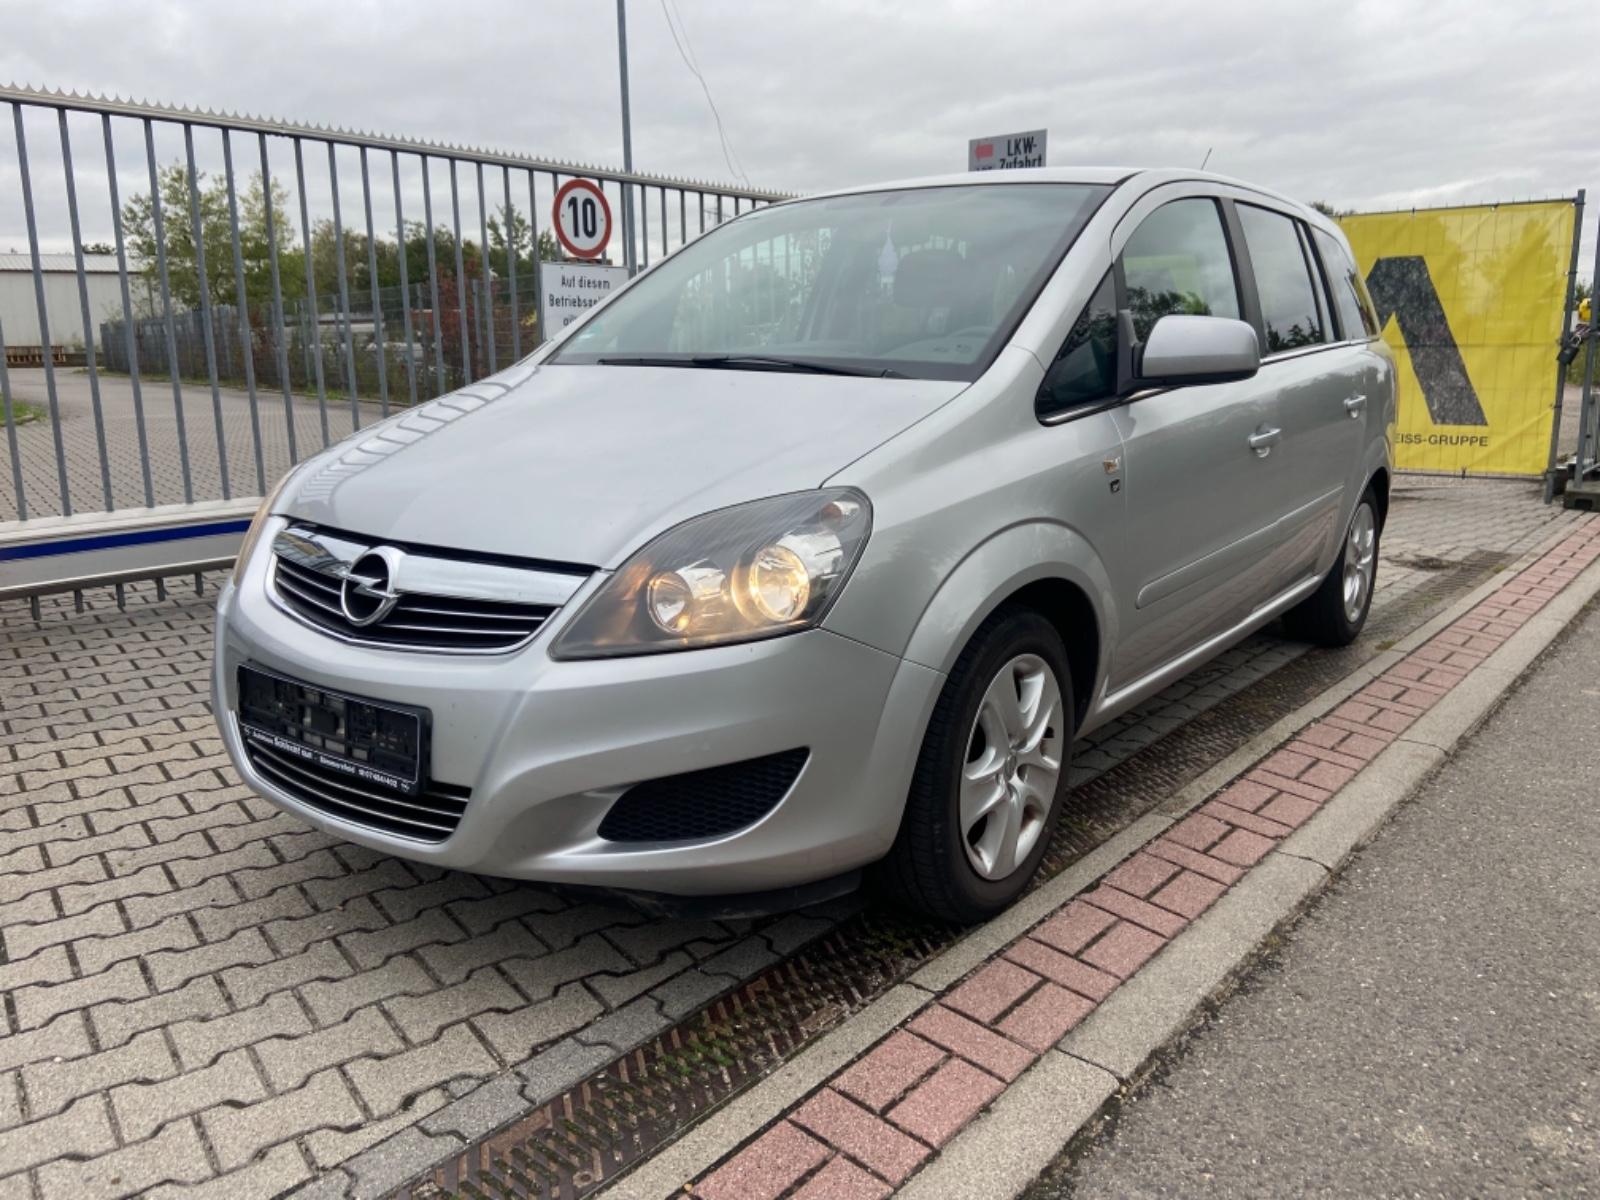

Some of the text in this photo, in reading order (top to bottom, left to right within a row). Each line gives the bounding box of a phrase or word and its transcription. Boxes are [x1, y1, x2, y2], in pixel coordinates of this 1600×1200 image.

[1007, 136, 1037, 156] LKW-
[1000, 153, 1042, 169] Zufahrt
[568, 196, 597, 238] 10
[561, 275, 610, 289] Auf diesem
